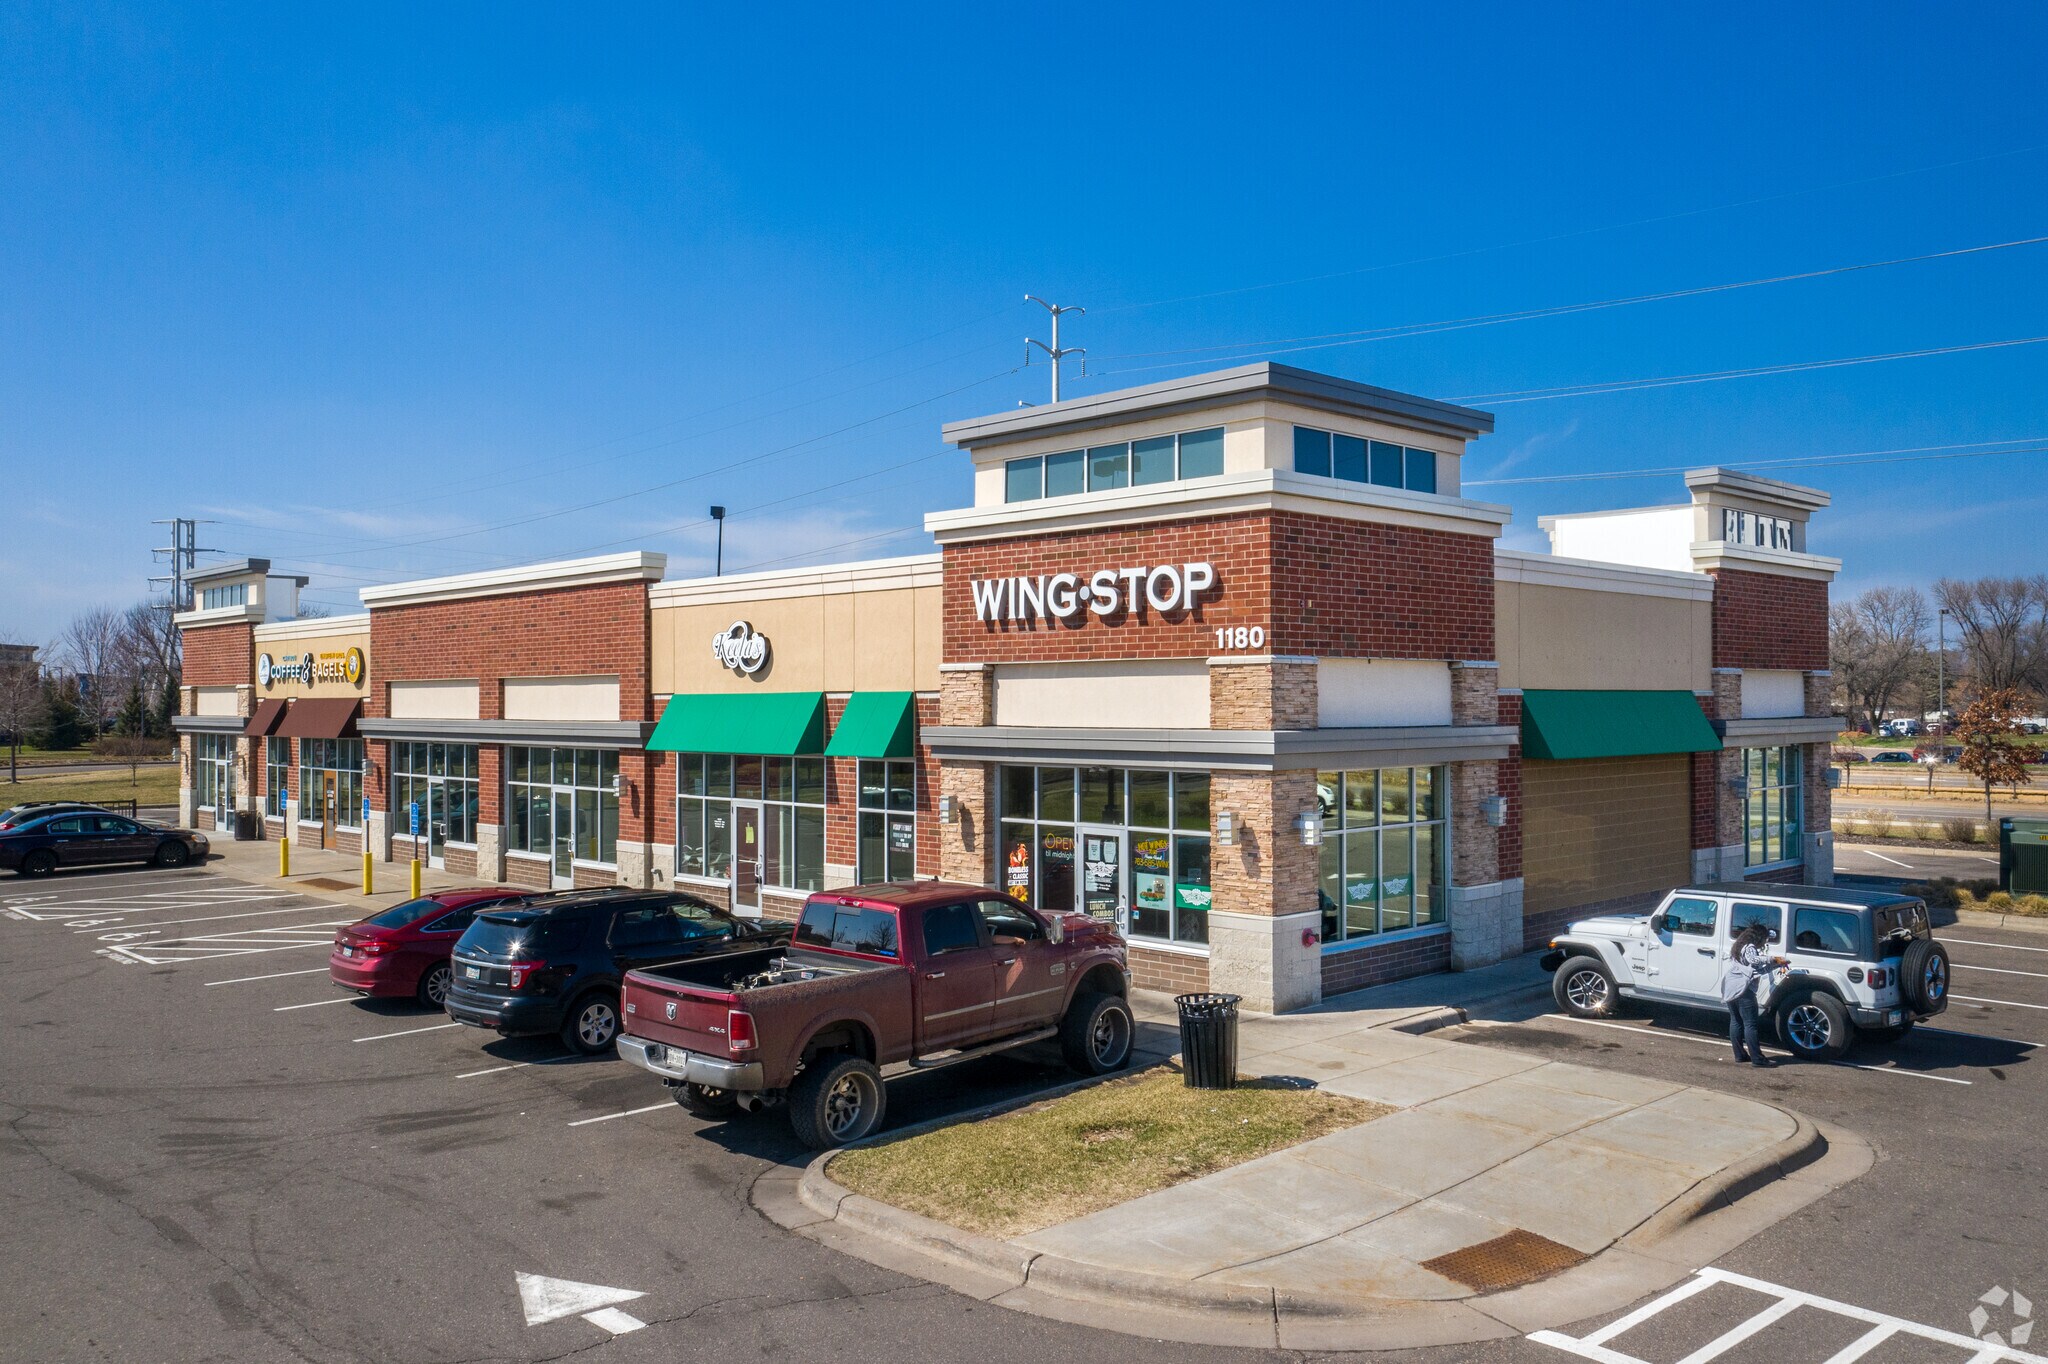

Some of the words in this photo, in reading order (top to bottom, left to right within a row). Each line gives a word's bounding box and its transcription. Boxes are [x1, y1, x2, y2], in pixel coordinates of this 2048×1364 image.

[1215, 626, 1265, 650] 1180
[271, 665, 300, 679] COFFEE
[312, 663, 344, 678] BAGELS
[1089, 903, 1106, 911] LUNCH
